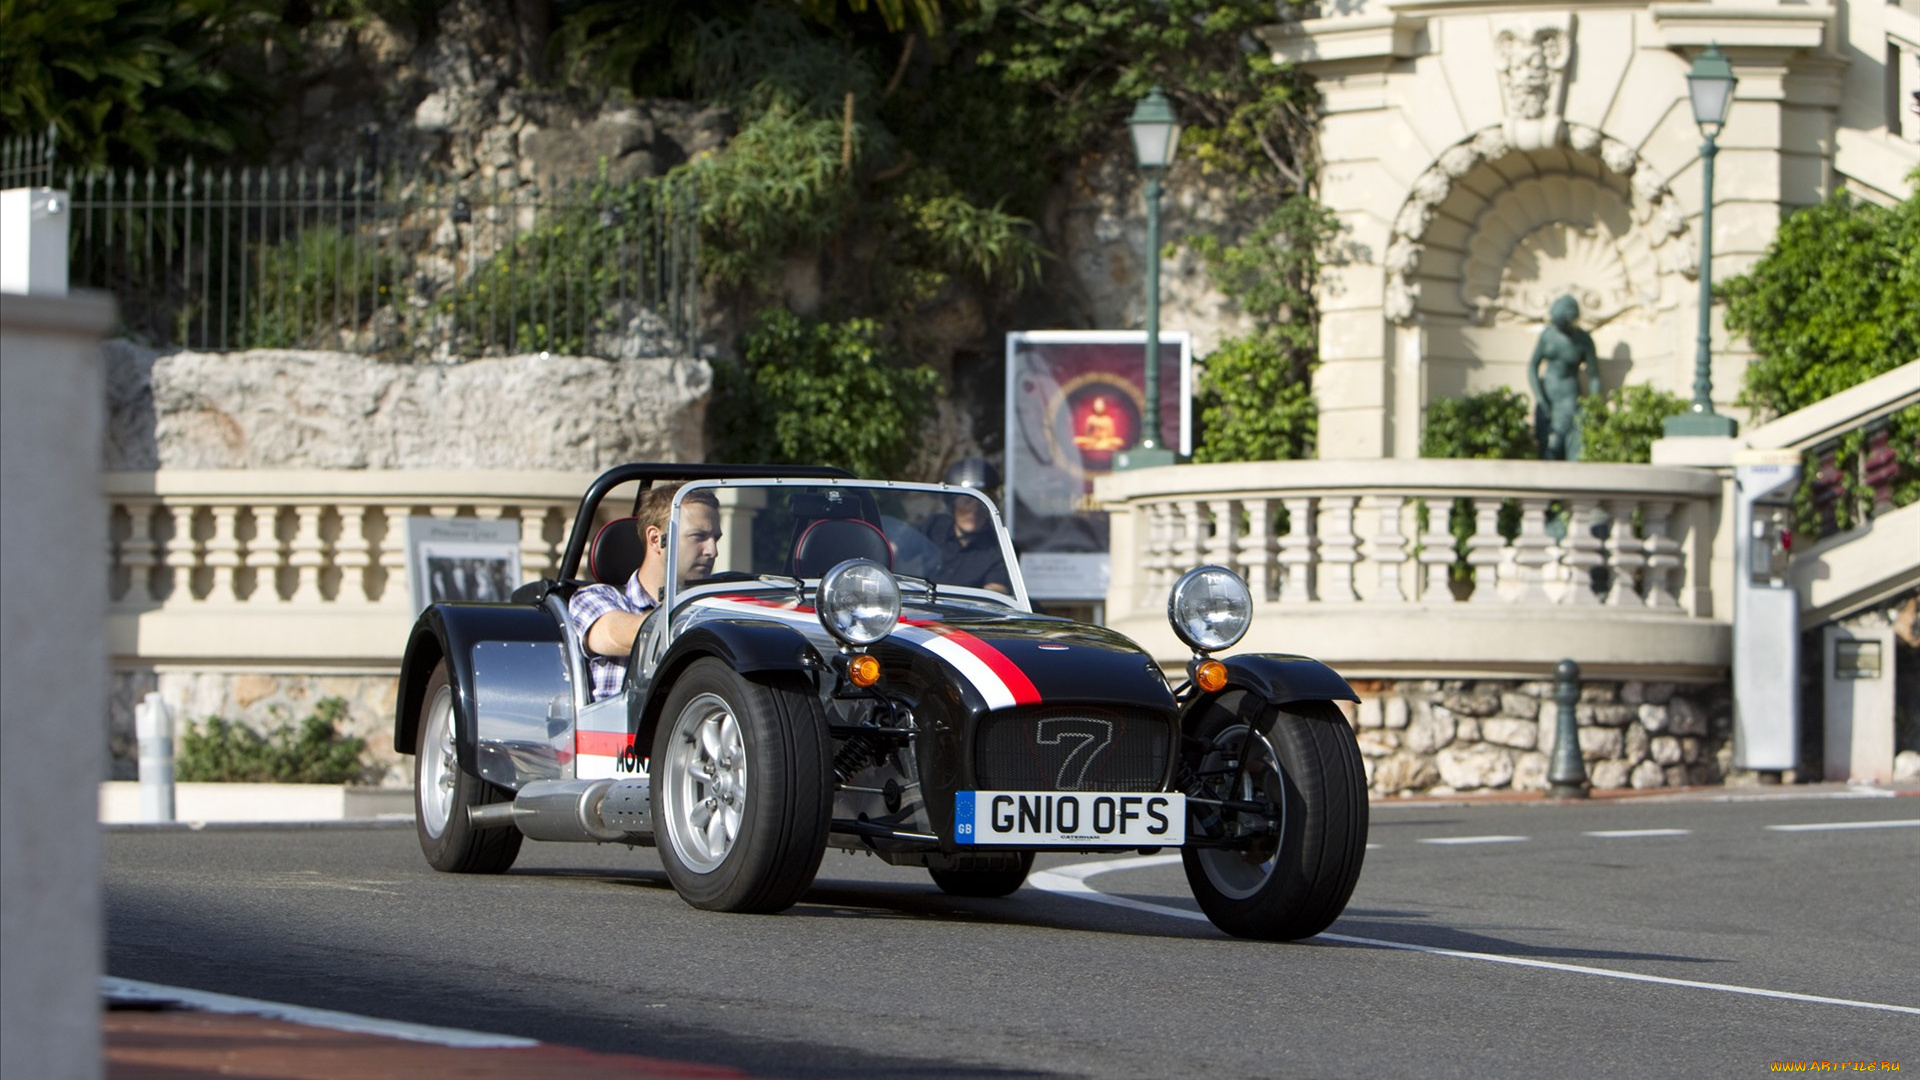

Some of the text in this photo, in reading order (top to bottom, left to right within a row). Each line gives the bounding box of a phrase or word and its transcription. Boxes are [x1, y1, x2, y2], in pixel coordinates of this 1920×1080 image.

[616, 743, 651, 773] MON
[1037, 717, 1113, 790] 7
[958, 823, 972, 834] GB
[991, 795, 1169, 835] GN10 OFS
